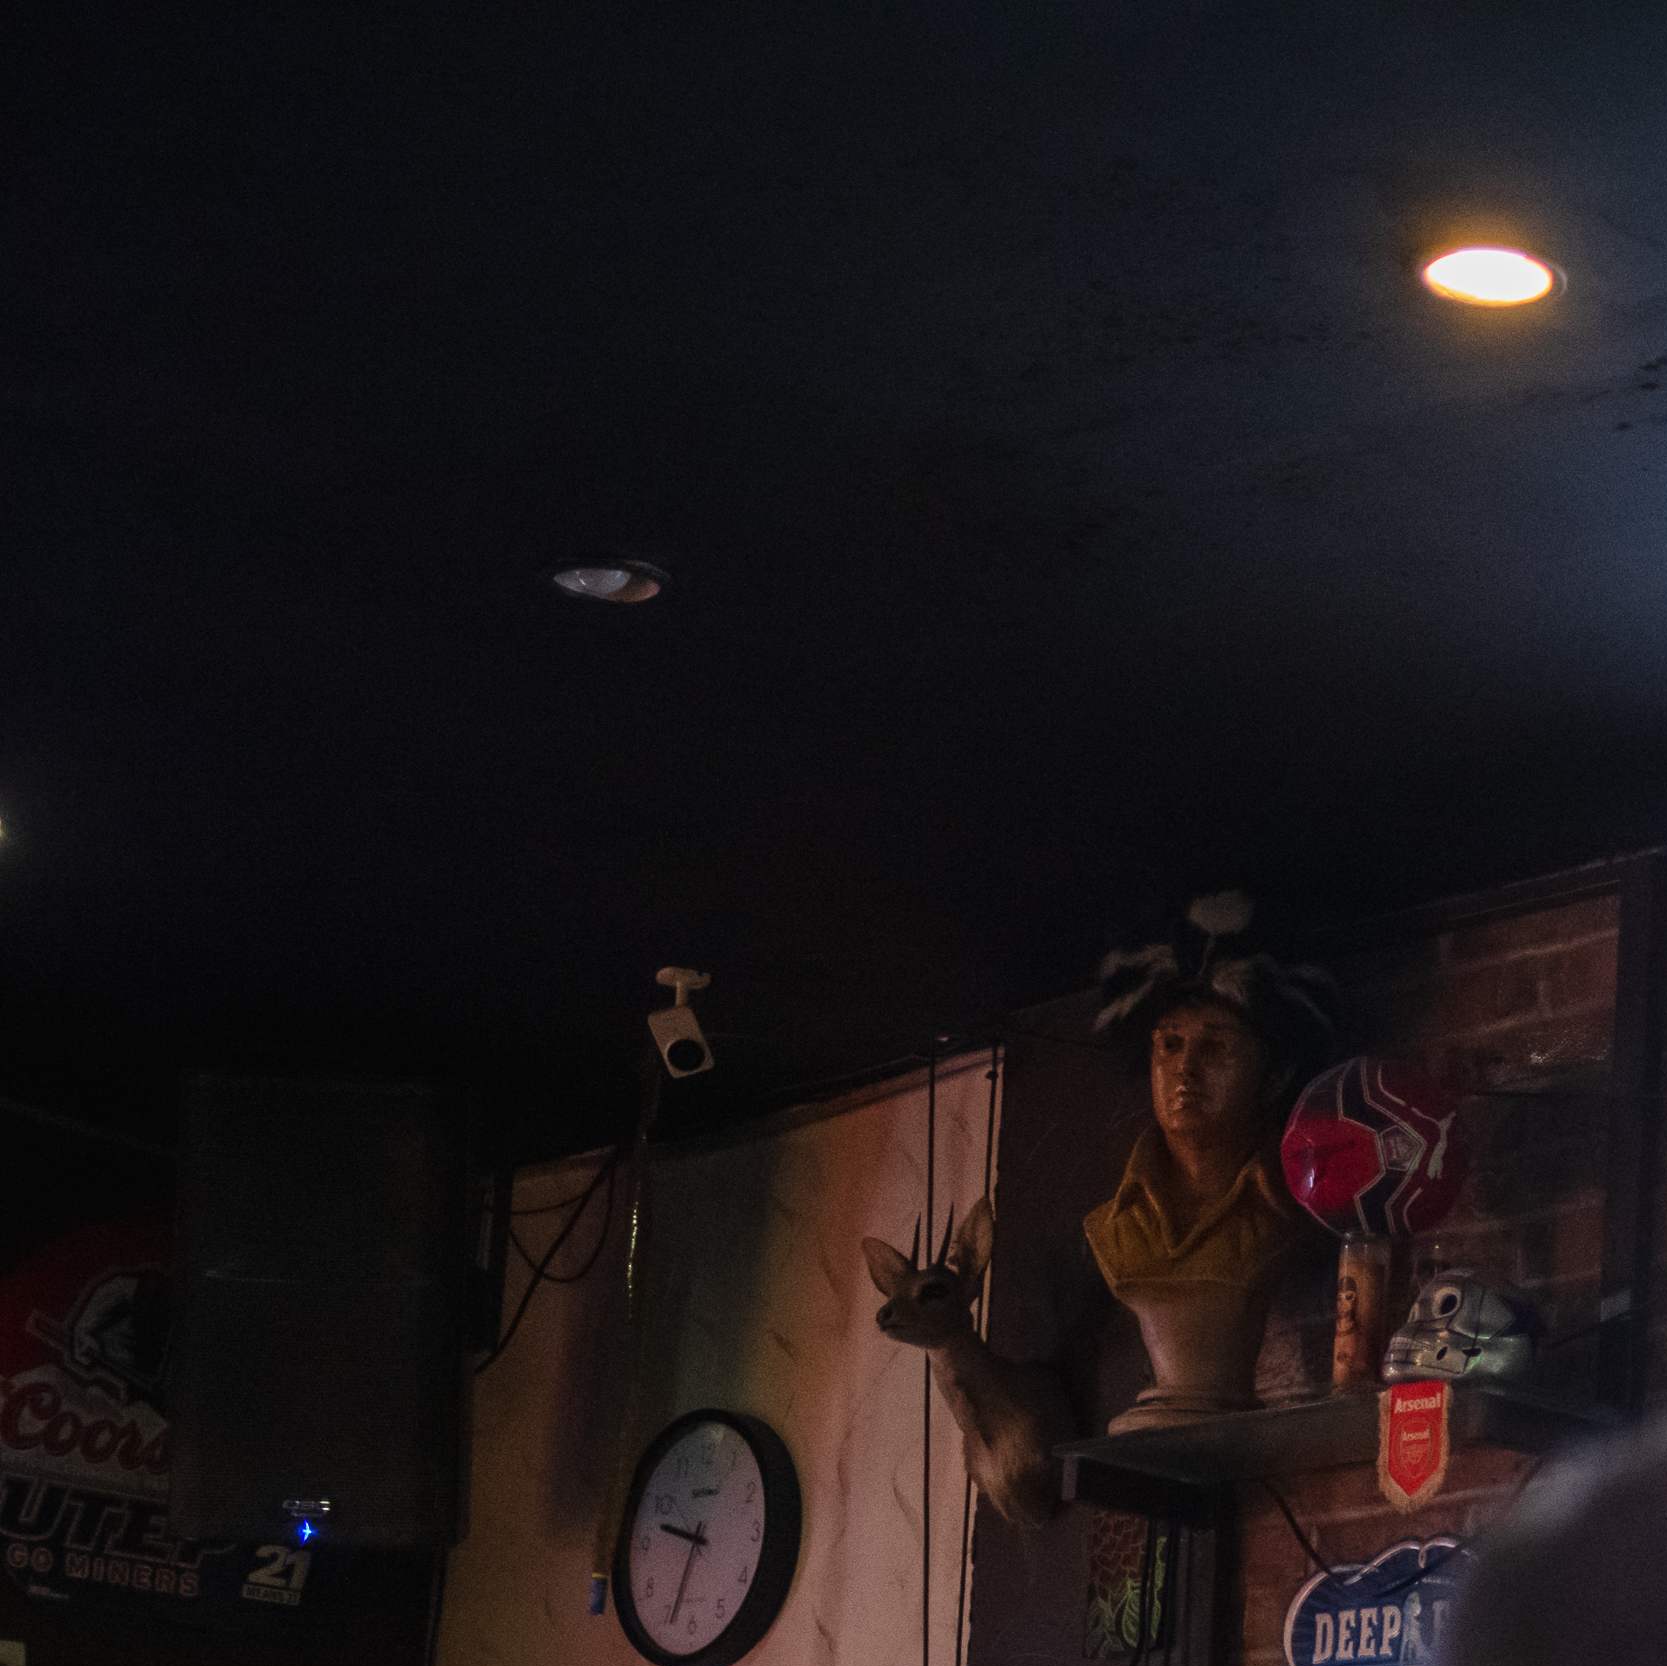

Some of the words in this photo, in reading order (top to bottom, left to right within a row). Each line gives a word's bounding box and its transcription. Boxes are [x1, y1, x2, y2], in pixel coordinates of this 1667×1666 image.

[1393, 1391, 1442, 1415] Arsenal
[8, 1542, 53, 1573] GO
[64, 1553, 200, 1599] MINERS
[247, 1544, 309, 1590] 21
[1312, 1605, 1402, 1665] DEEP
